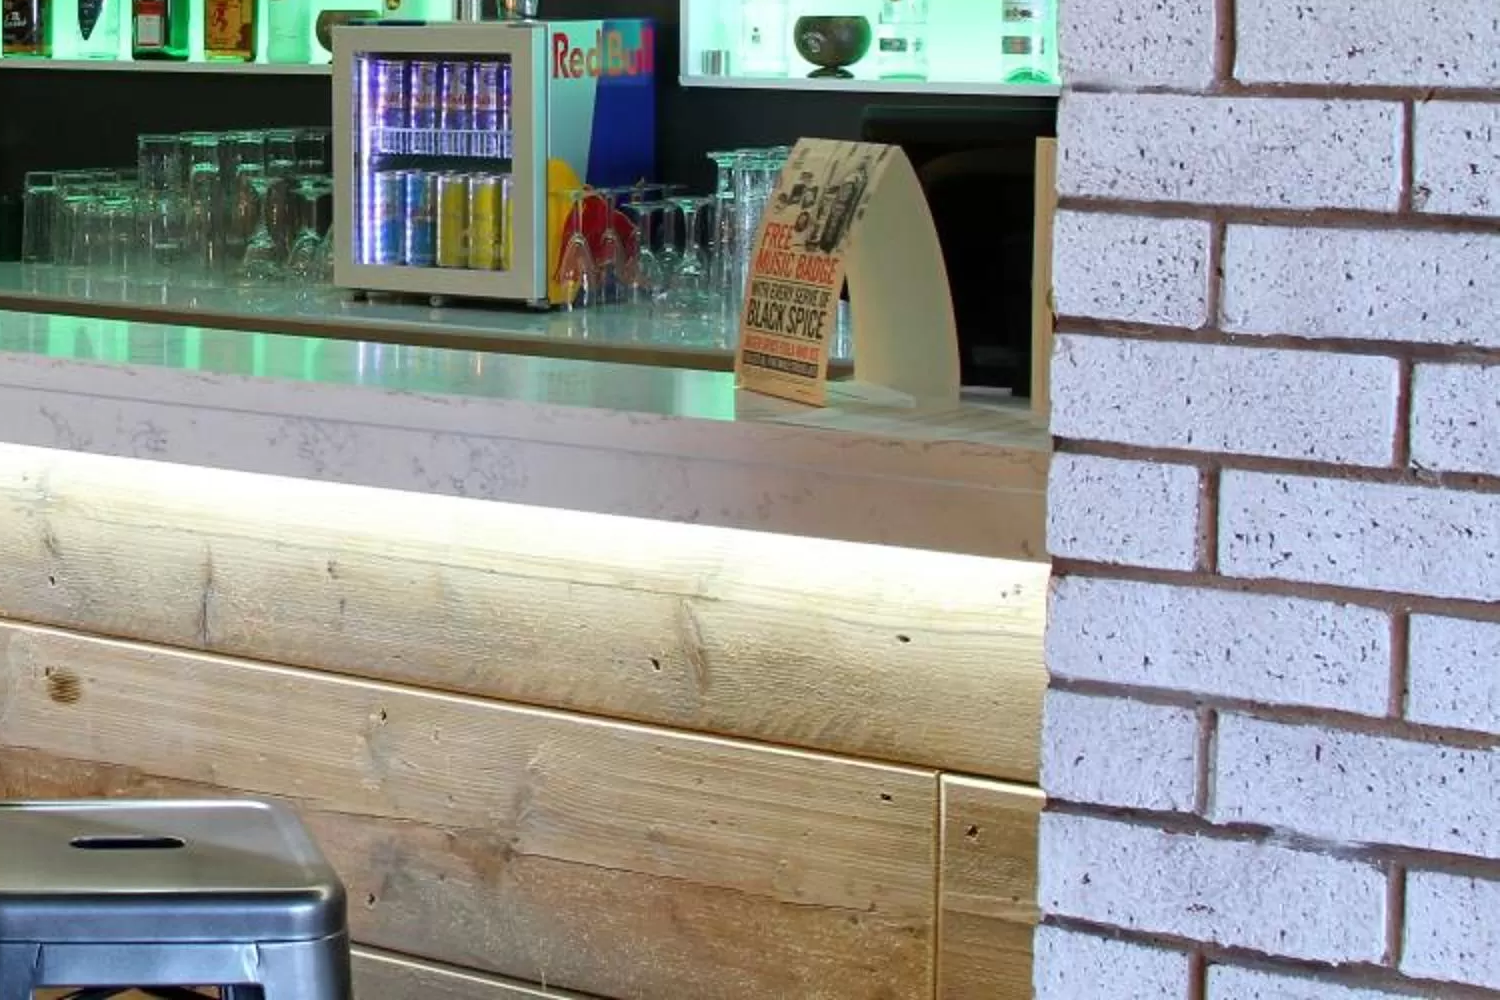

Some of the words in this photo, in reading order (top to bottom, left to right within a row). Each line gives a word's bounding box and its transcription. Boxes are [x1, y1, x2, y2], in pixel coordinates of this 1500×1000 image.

[553, 28, 602, 78] Red
[608, 24, 654, 76] Bull
[761, 222, 794, 249] FREE
[746, 298, 787, 332] BLACK
[786, 305, 827, 339] SPICE
